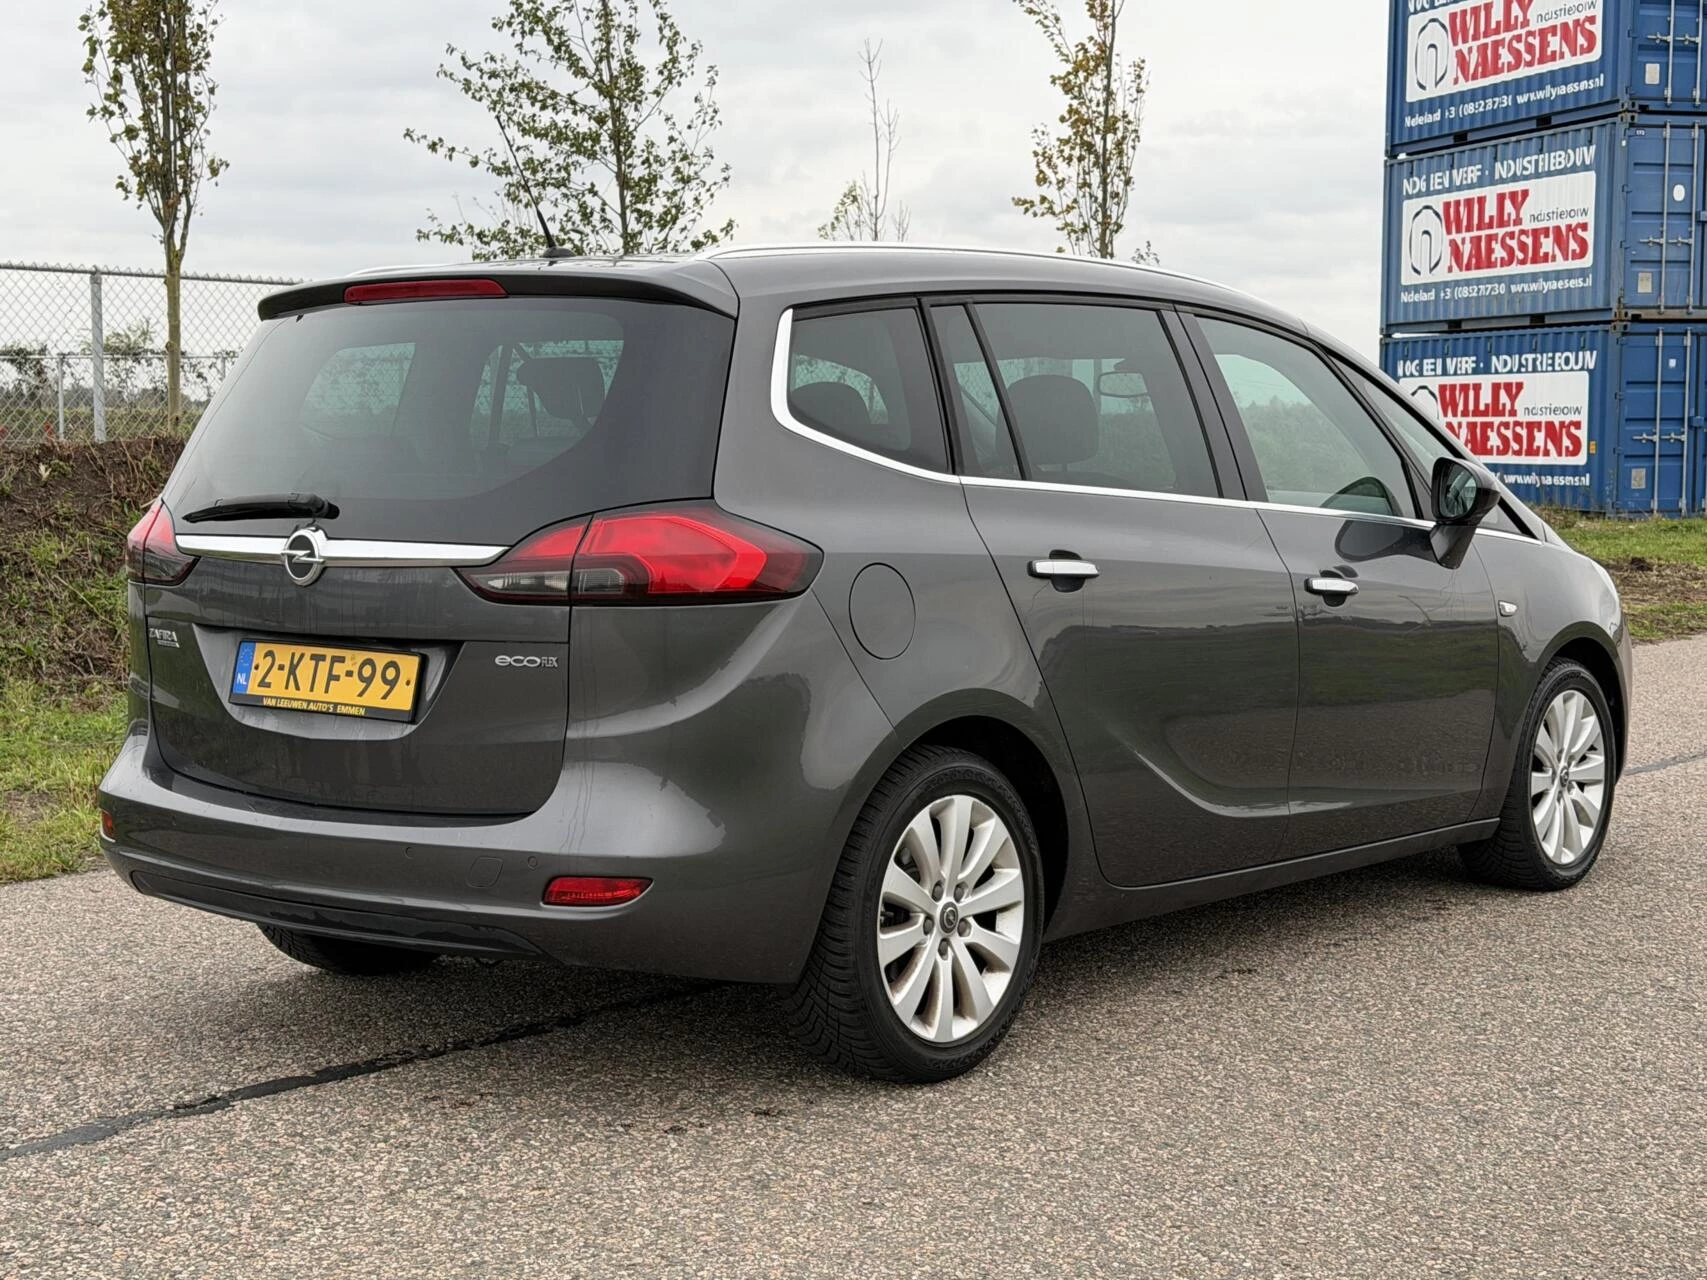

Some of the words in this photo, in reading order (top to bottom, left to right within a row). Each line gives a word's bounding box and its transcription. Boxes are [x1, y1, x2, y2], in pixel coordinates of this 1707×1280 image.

[1449, 0, 1531, 46] WILLY
[1453, 14, 1597, 85] NAESSENS
[1442, 188, 1530, 236] WILLY
[1447, 222, 1589, 273] NAESSENS
[1438, 382, 1524, 418] WILLY
[236, 672, 247, 685] NL
[257, 649, 401, 700] 2-KTF-99
[262, 697, 277, 707] VAN
[277, 698, 308, 710] LEEUWEN
[308, 700, 334, 712] AUTO'S
[337, 705, 366, 717] EMMEN
